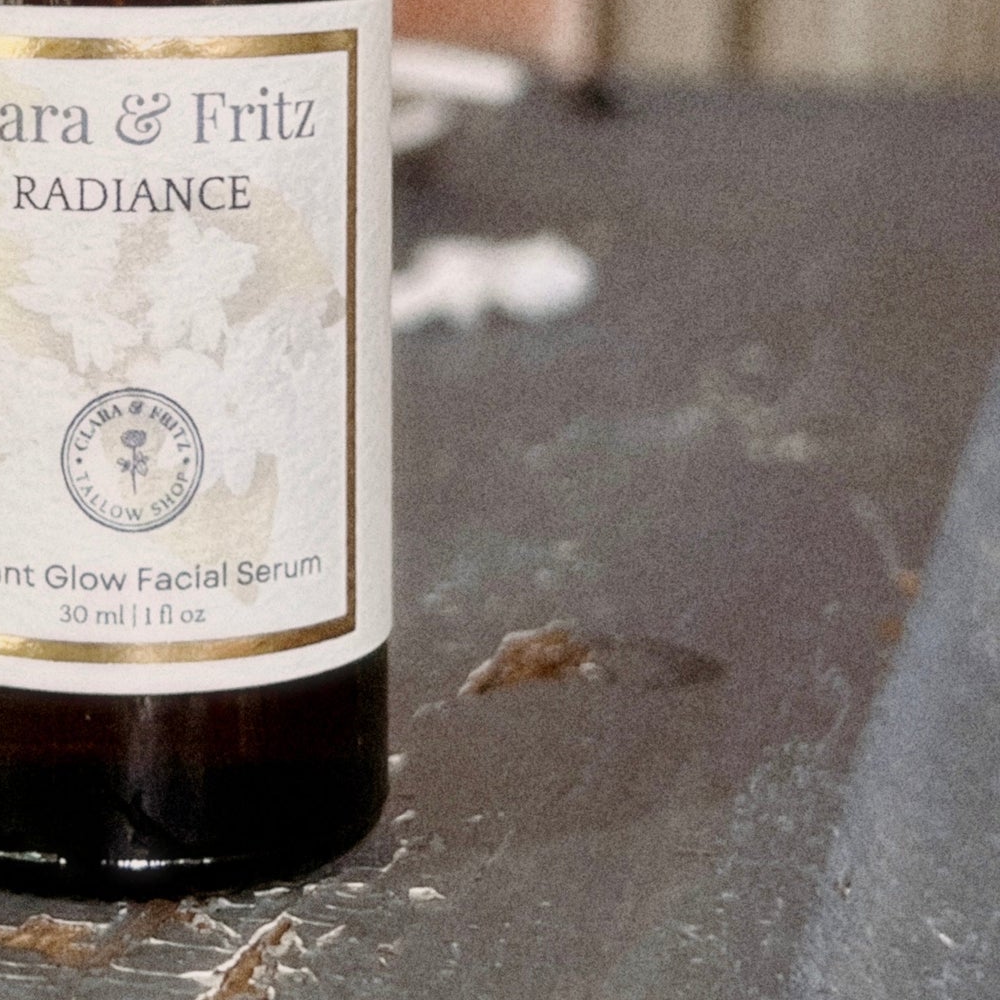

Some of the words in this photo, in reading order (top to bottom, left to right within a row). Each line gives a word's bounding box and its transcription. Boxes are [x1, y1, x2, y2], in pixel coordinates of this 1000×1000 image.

[115, 92, 171, 146] &
[192, 86, 317, 145] Fritz
[13, 175, 251, 213] RADIANCE
[76, 471, 143, 521] TALLOW
[151, 472, 189, 516] SHOP
[44, 563, 127, 591] Glow
[138, 562, 228, 591] Facial
[237, 554, 322, 586] Serum
[59, 604, 88, 624] 30
[96, 604, 125, 625] ml
[159, 604, 173, 625] fl
[180, 609, 206, 624] oz
